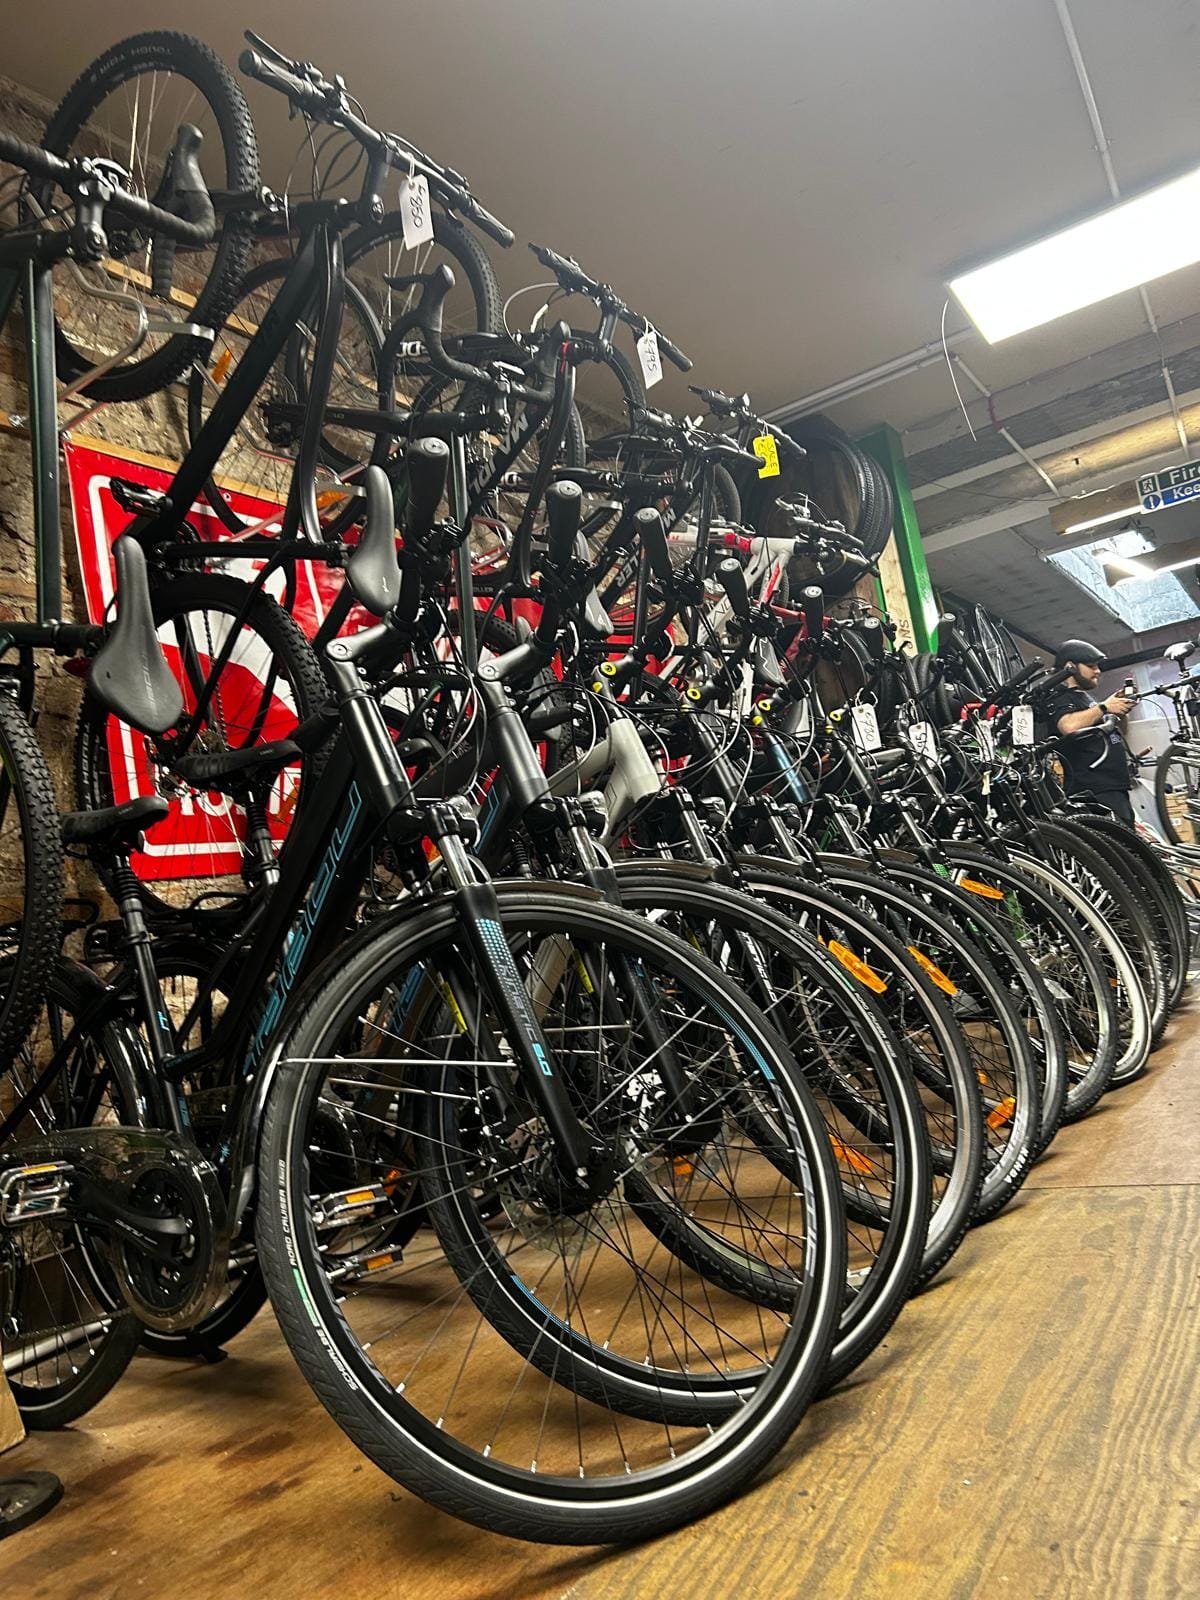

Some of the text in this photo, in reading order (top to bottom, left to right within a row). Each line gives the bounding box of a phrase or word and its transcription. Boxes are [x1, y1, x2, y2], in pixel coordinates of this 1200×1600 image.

[1169, 466, 1200, 485] Fir
[1003, 1146, 1030, 1183] KENDA
[279, 1189, 291, 1233] CRUISER
[285, 1236, 297, 1266] ROAD
